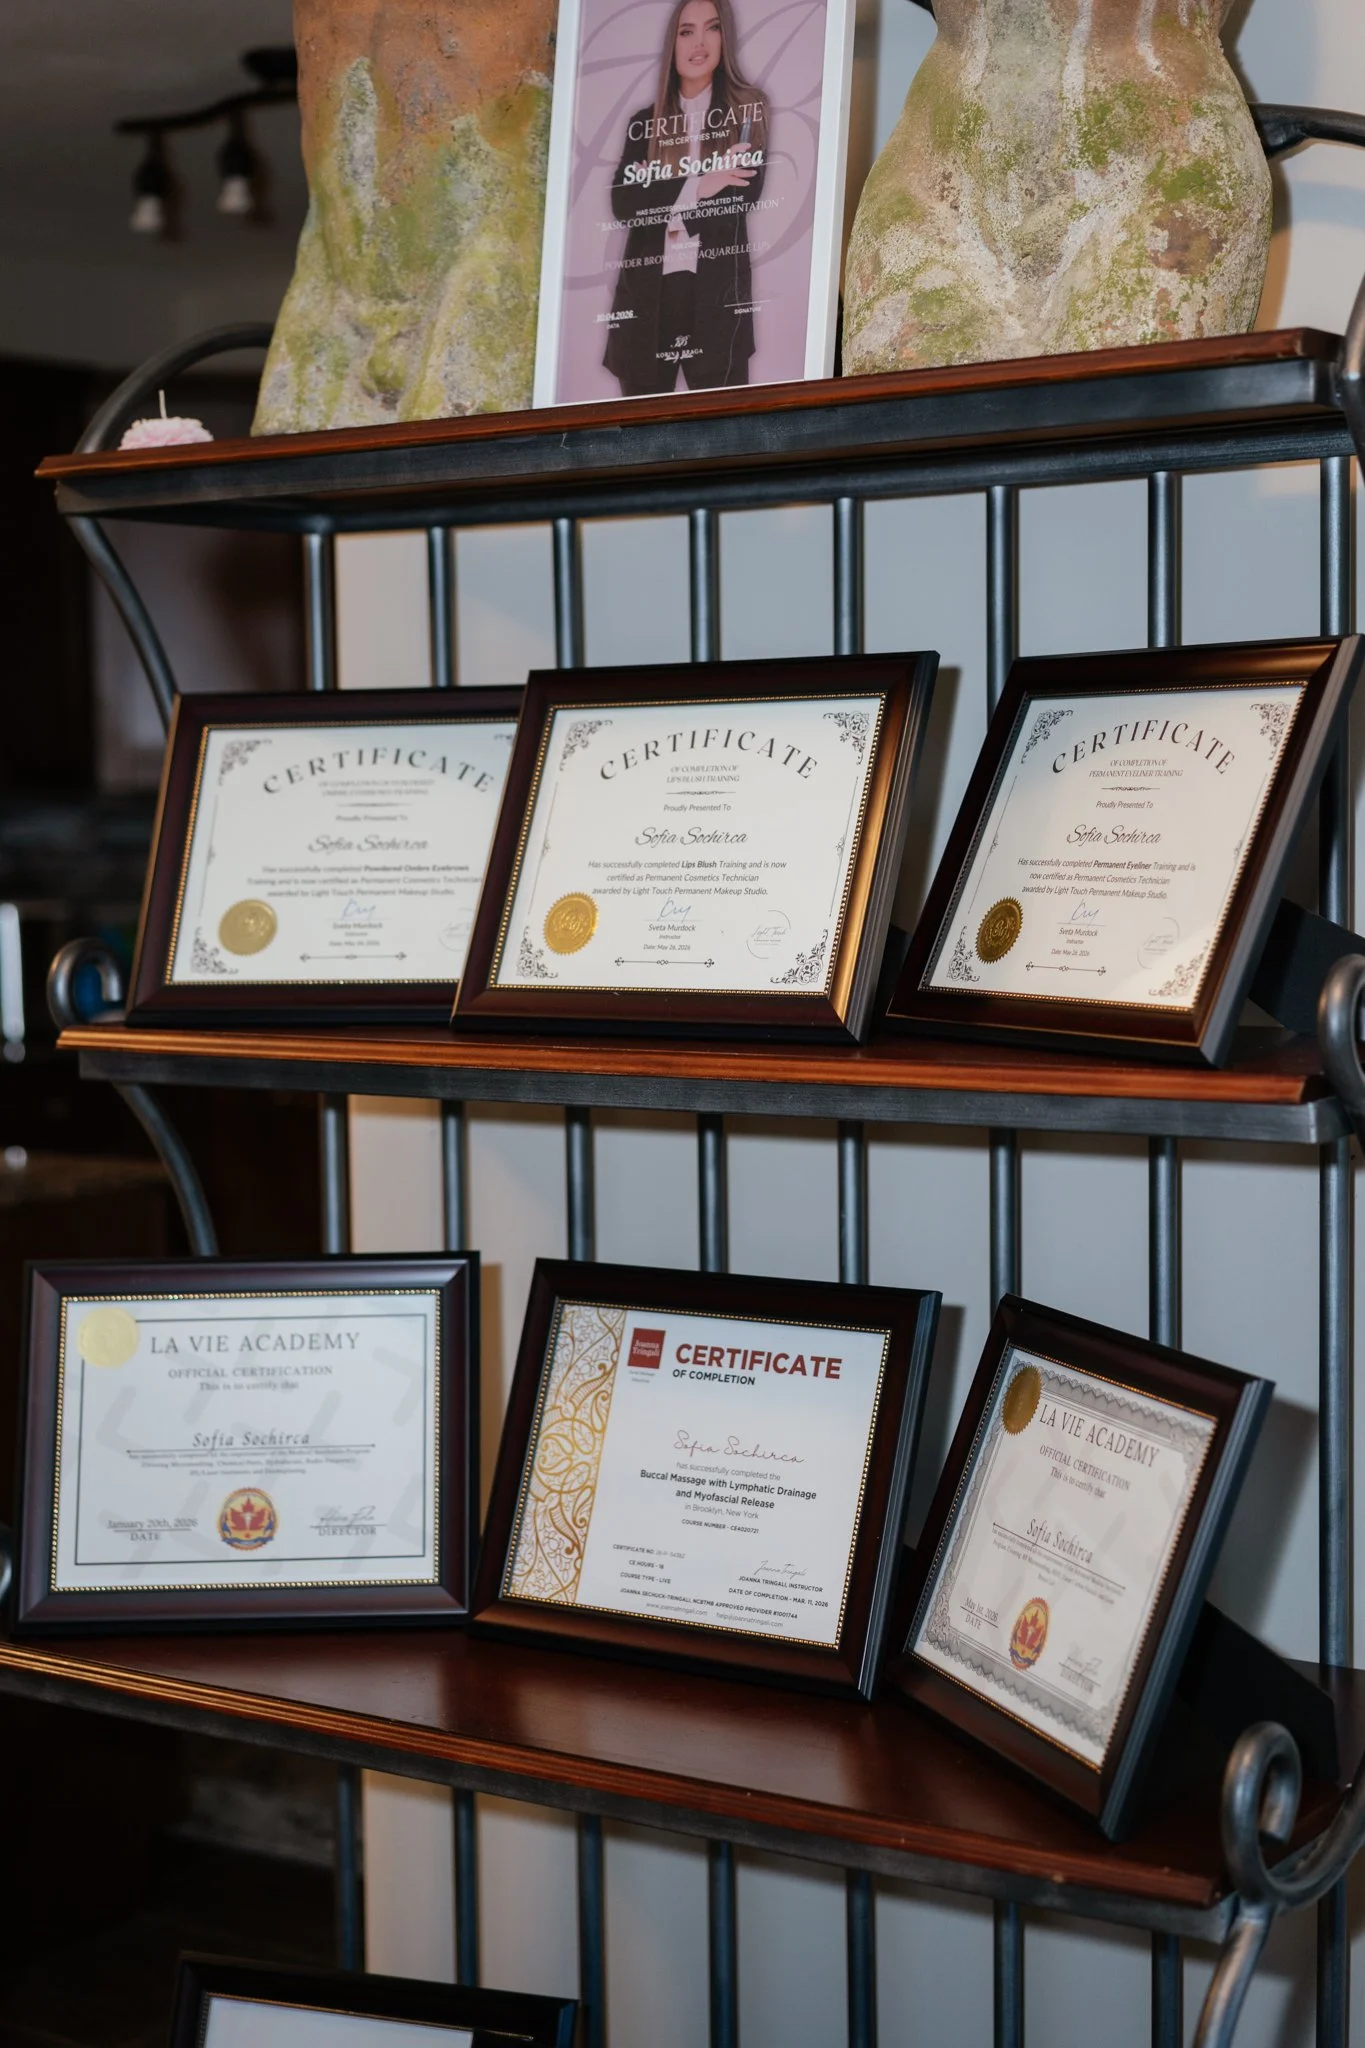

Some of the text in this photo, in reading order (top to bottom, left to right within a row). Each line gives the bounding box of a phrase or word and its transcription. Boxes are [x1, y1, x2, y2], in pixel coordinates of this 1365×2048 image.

[628, 102, 763, 141] CERTIFICATE
[659, 138, 674, 148] THIS
[711, 130, 730, 140] THAT
[623, 149, 763, 188] Sofia Sochirca
[627, 214, 663, 228] COURSE
[678, 201, 779, 221] MICROPIGMENTATION
[698, 244, 751, 260] AQUARELLE
[600, 728, 818, 780] CERTIFICATE
[1052, 720, 1235, 775] CERTIFICATE
[263, 747, 495, 794] CERTIFICATE
[663, 804, 687, 813] Proudly
[689, 804, 721, 812] Presented
[1096, 801, 1154, 809] Proudly Presented To
[635, 826, 748, 848] Sofia Sochirca
[1066, 824, 1161, 847] Sofia Sochirca
[588, 860, 601, 868] Has
[603, 860, 642, 870] successfully
[643, 860, 680, 870] completed
[681, 860, 695, 870] Lips
[697, 860, 717, 868] Blush
[719, 860, 746, 870] Training
[748, 860, 762, 868] and
[763, 860, 769, 868] is
[1029, 858, 1061, 868] successfully
[1062, 859, 1093, 868] completed
[1093, 860, 1126, 869] Permanent
[1127, 861, 1152, 870] Eyeliner
[1153, 862, 1177, 872] Training
[1177, 863, 1190, 871] and
[1190, 863, 1196, 871] is
[606, 873, 634, 881] certified
[645, 873, 682, 882] Permanent
[684, 873, 720, 882] Cosmetics
[722, 873, 759, 882] Technician
[1042, 872, 1066, 880] certified
[1074, 874, 1105, 882] Permanent
[1107, 875, 1136, 883] Cosmetics
[1138, 876, 1170, 885] Technician
[592, 887, 768, 896] awarded by Light Touch Permanent Makeup Studio.
[1046, 886, 1053, 894] by
[1054, 886, 1069, 896] Light
[1070, 887, 1087, 895] Touch
[1089, 888, 1121, 896] Permanent
[1121, 889, 1146, 899] Makeup
[648, 923, 696, 932] Sveta Murdock
[1059, 927, 1098, 937] Sveta Murdock
[151, 1331, 360, 1354] LA VIE ACADEMY
[675, 1343, 843, 1380] CERTIFICATE
[168, 1366, 333, 1379] OFFICIAL CERTIFICATION
[672, 1369, 755, 1386] OF COMPLETION
[192, 1428, 310, 1450] Sofia Sochirca
[1040, 1404, 1160, 1467] LA VIE ACADEMY
[673, 1430, 805, 1463] Sofia Sochirca
[676, 1462, 781, 1481] has successfully completed the
[1039, 1444, 1131, 1492] OFFICIAL CERTIFICATION
[640, 1469, 817, 1500] Buccal Massage with Lymphatic Drainage
[1051, 1466, 1062, 1479] This
[1075, 1477, 1093, 1495] certify
[675, 1489, 775, 1509] and Myofascial Release
[725, 1508, 741, 1517] New
[742, 1510, 759, 1520] York
[317, 1526, 377, 1537] DIRECTOR
[681, 1518, 703, 1528] COURSE
[704, 1521, 726, 1530] NUMBER
[130, 1531, 160, 1541] DATE
[1027, 1518, 1050, 1546] Sofia
[1052, 1530, 1093, 1564] Sochirca
[620, 1571, 641, 1580] COURSE
[642, 1574, 655, 1583] TYPE
[739, 1576, 760, 1584] JOANNA
[788, 1582, 823, 1593] INSTRUCTOR
[620, 1588, 641, 1596] JOANNA
[715, 1602, 744, 1611] APPROVED
[745, 1606, 772, 1615] PROVIDER
[728, 1587, 743, 1595] DATE
[753, 1591, 788, 1601] COMPLETION
[814, 1600, 829, 1608] 2026
[964, 1597, 978, 1614] May
[985, 1607, 999, 1622] 2026
[965, 1614, 982, 1630] DATE
